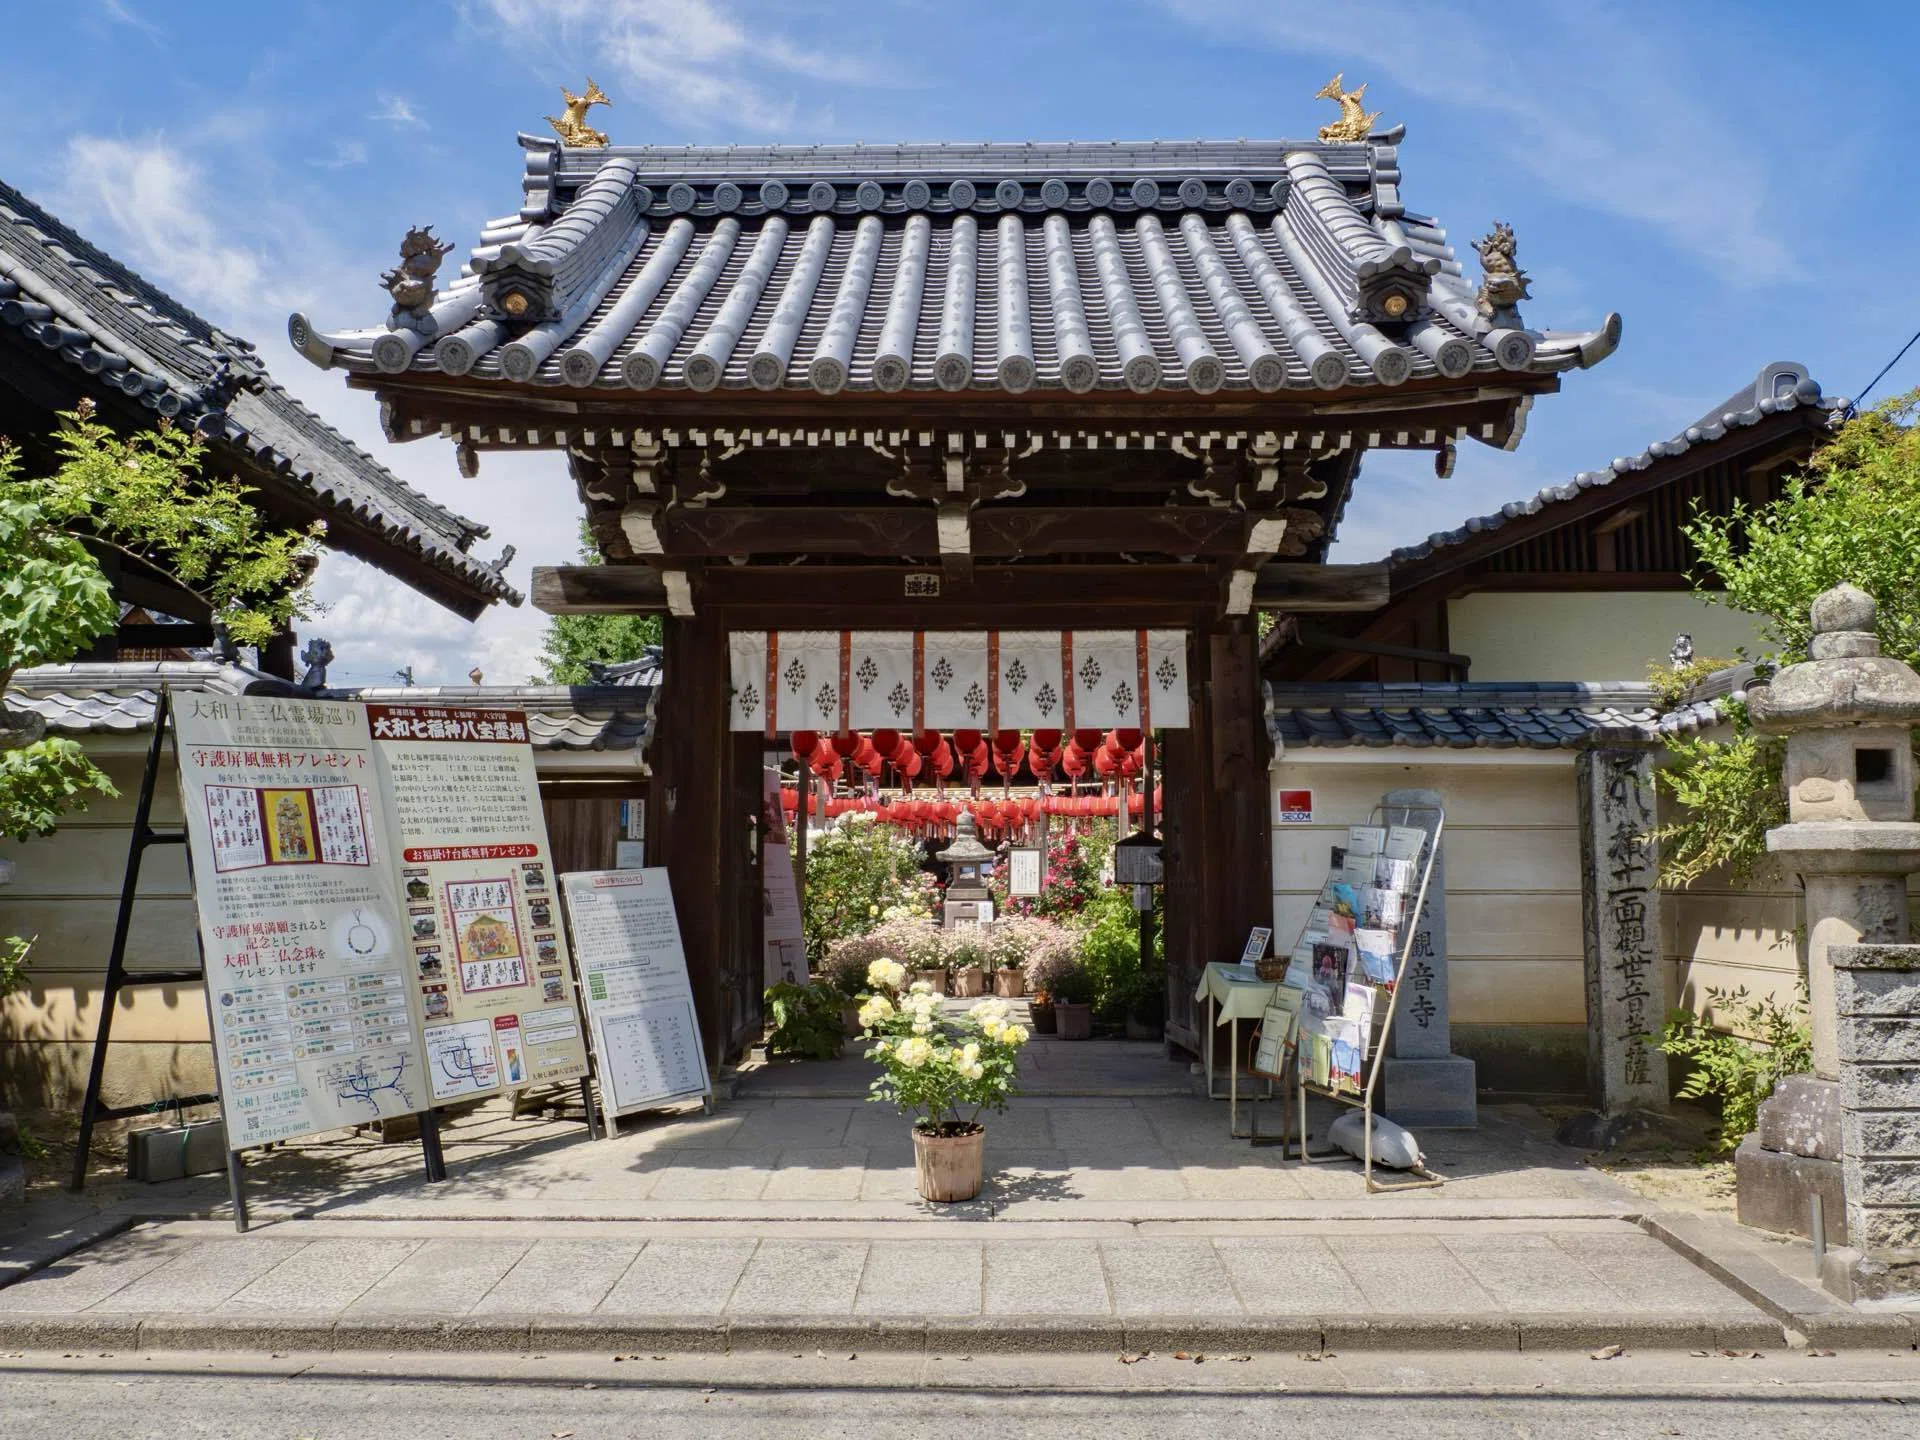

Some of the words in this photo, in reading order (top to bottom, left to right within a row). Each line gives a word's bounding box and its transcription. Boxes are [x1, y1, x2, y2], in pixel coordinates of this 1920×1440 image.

[186, 699, 357, 726] 大和十三仏霊場巡り
[374, 717, 526, 741] 大和七福神八宝霊場
[191, 750, 367, 769] 守護屏風無料プレゼント
[413, 845, 531, 861] お福掛け台紙無料プレゼント
[213, 920, 328, 939] 守護屏風満願されると
[246, 936, 301, 951] 記念として
[224, 949, 327, 968] 大和十三仏念珠を
[236, 962, 317, 979] プレゼントします
